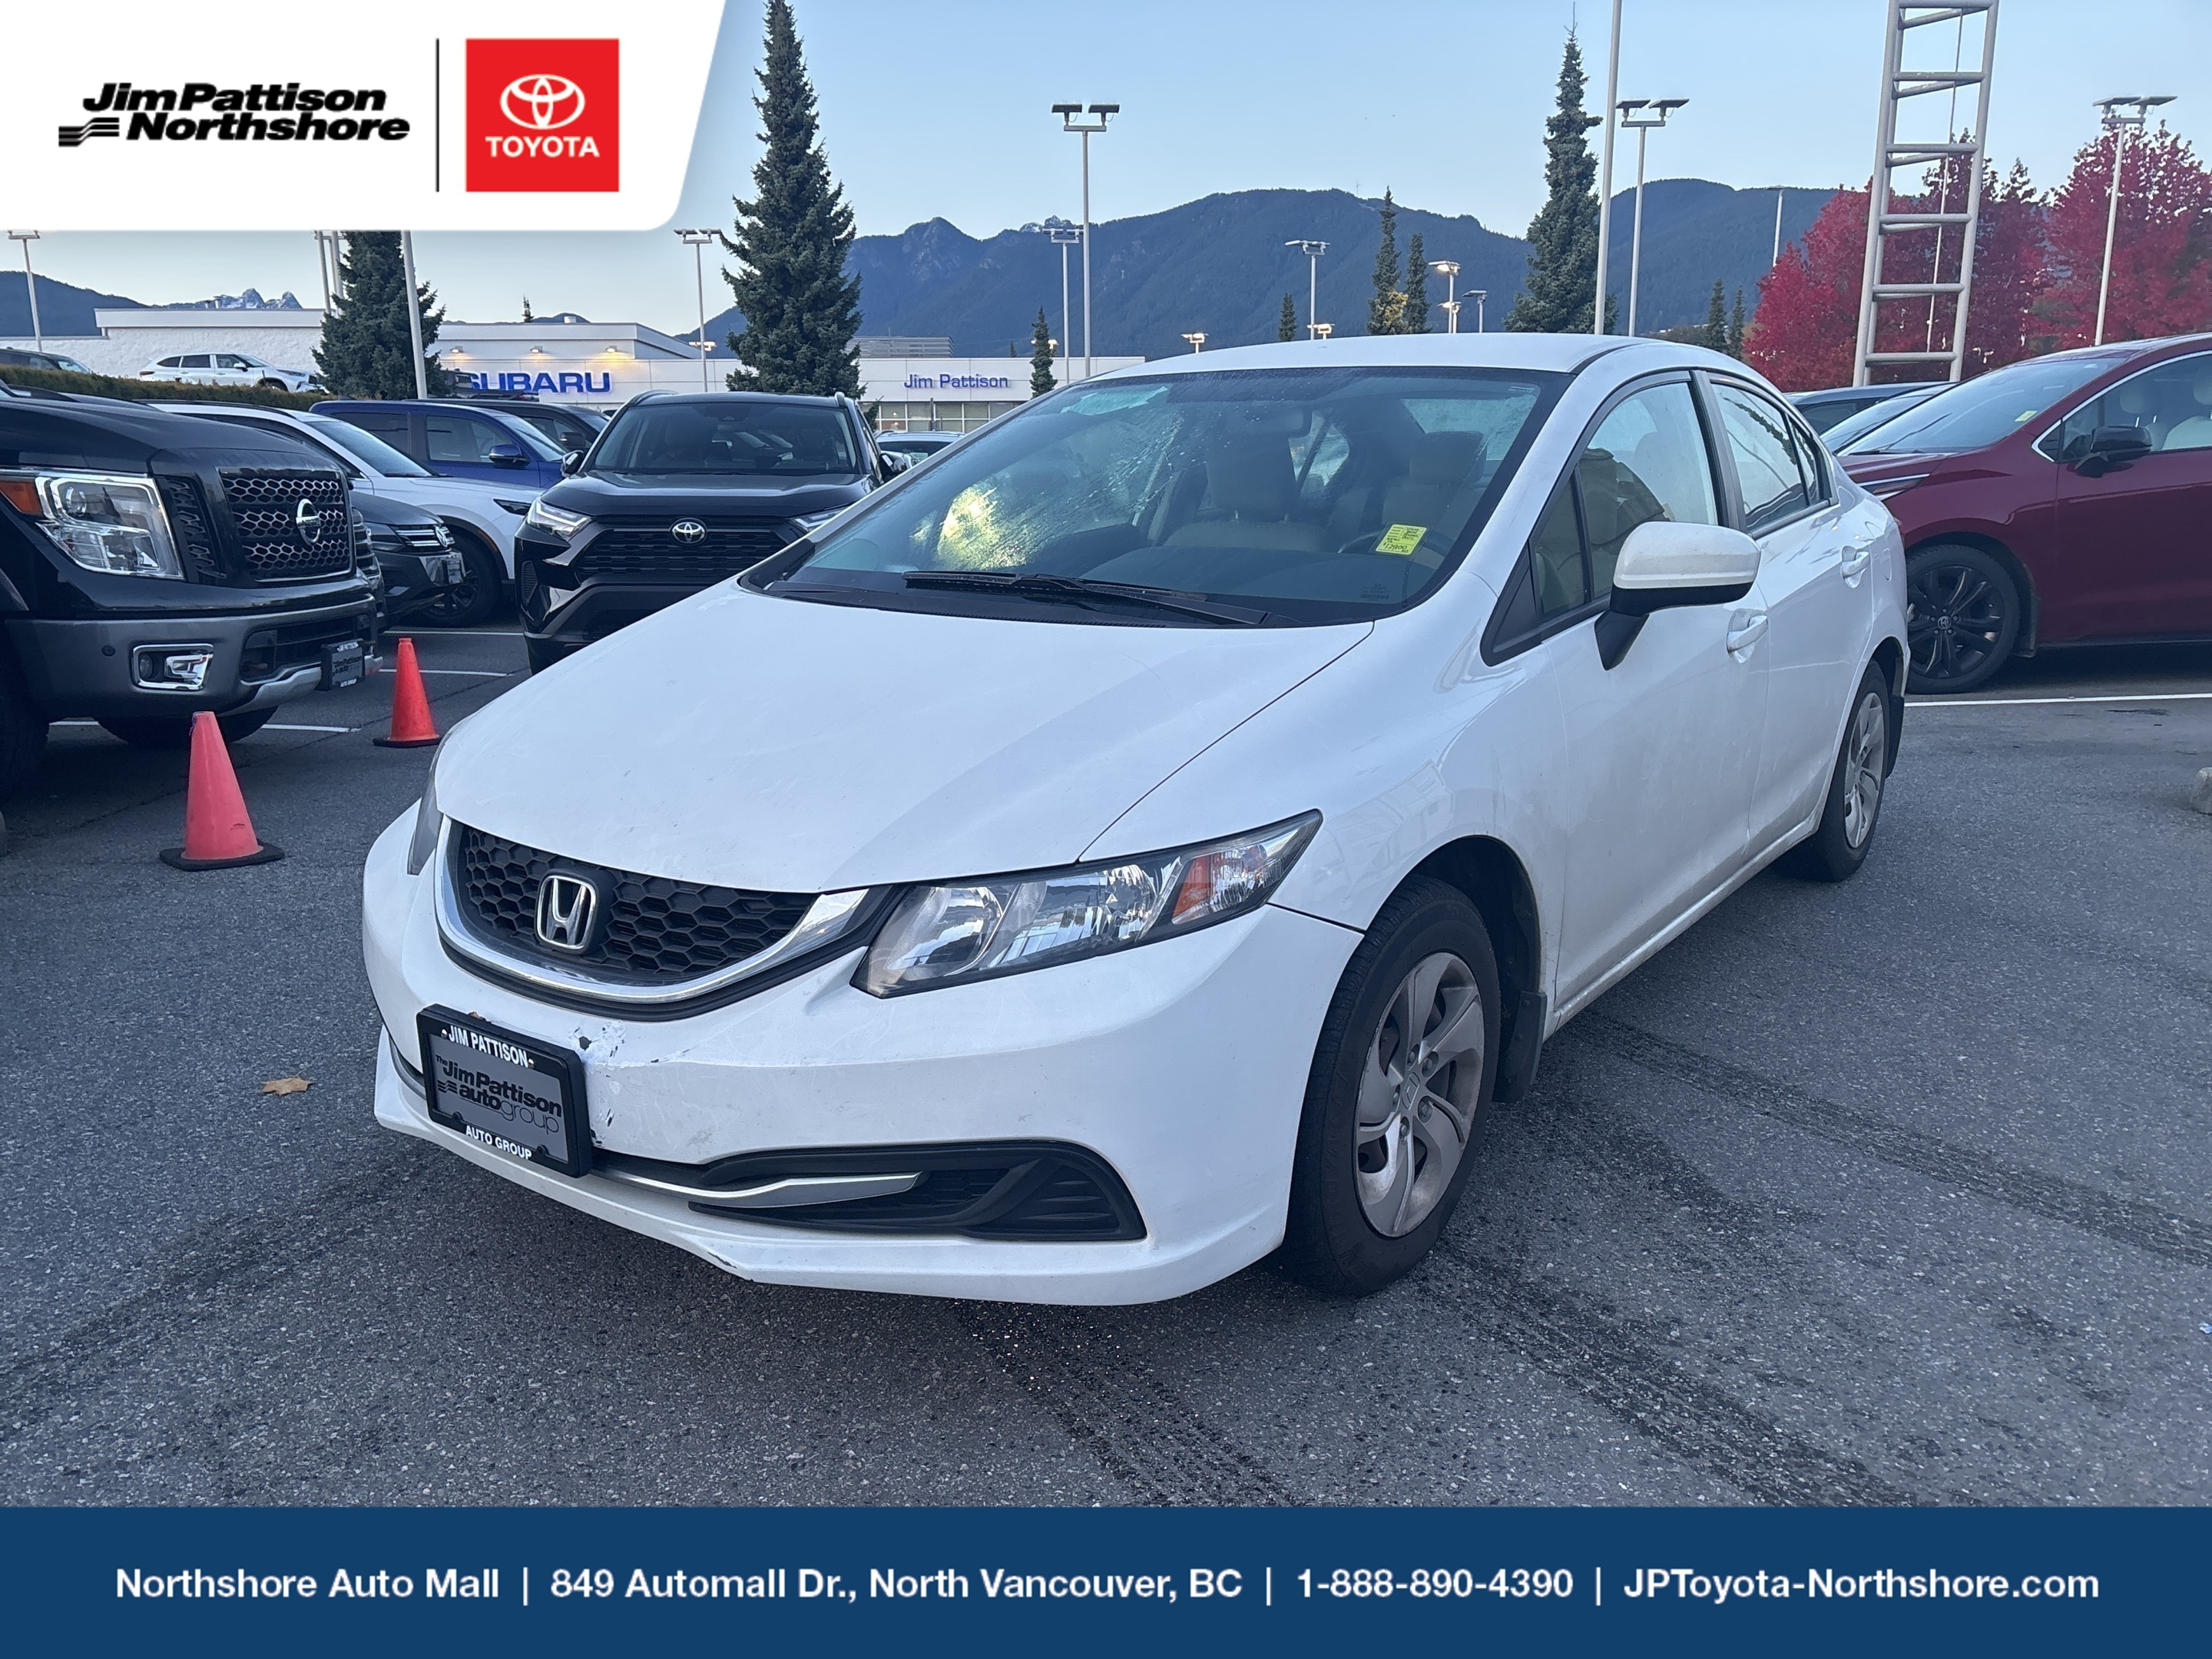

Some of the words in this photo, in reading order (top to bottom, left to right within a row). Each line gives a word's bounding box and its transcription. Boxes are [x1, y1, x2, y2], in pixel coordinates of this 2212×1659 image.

[903, 374, 933, 389] Jim
[939, 373, 1008, 389] Pattison
[449, 1025, 469, 1047] JIM
[470, 1031, 528, 1068] PATTISON
[435, 1054, 449, 1067] The
[465, 1124, 493, 1145] AUTO
[495, 1136, 532, 1161] GROUP
